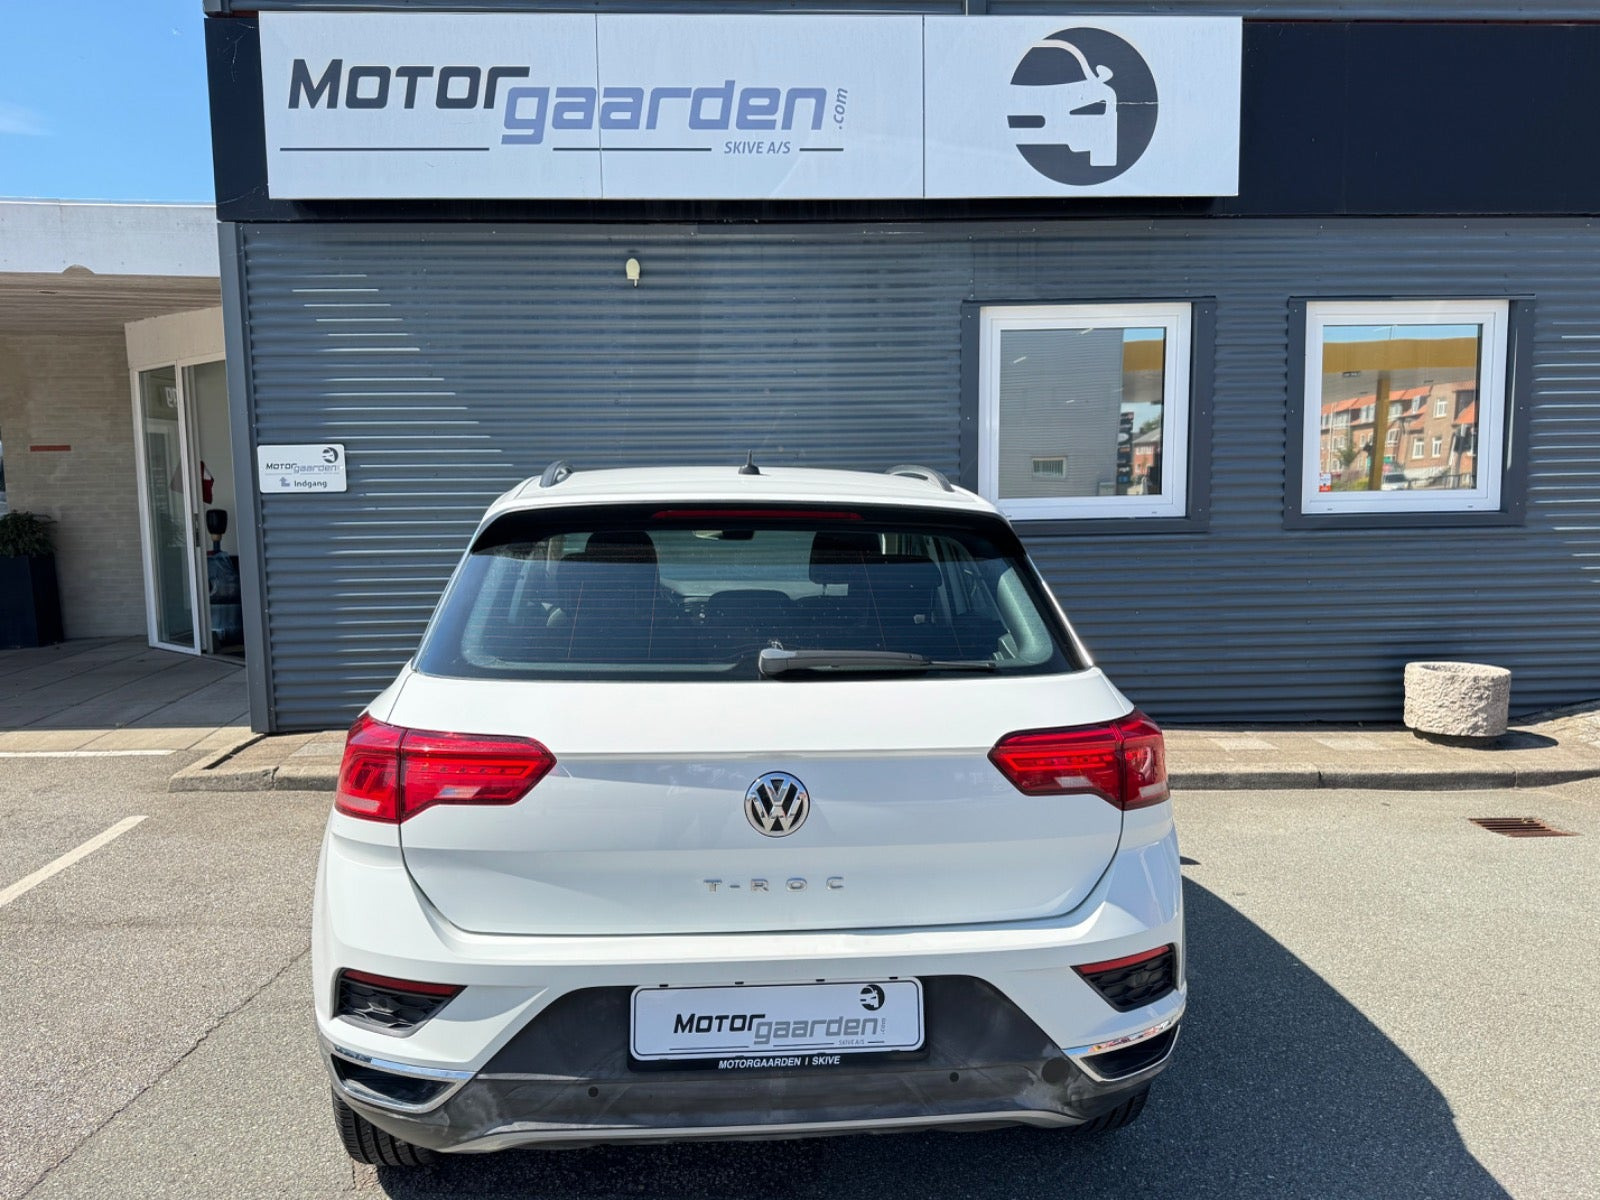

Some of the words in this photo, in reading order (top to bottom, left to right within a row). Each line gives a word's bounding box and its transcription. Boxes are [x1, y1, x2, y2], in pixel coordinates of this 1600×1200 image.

[833, 88, 848, 130] .com
[724, 141, 764, 154] SKIVE
[767, 141, 791, 154] A/S
[294, 480, 328, 488] Indgang
[718, 1057, 801, 1069] MOTORGAARDEN
[811, 1055, 841, 1065] SKIVE
